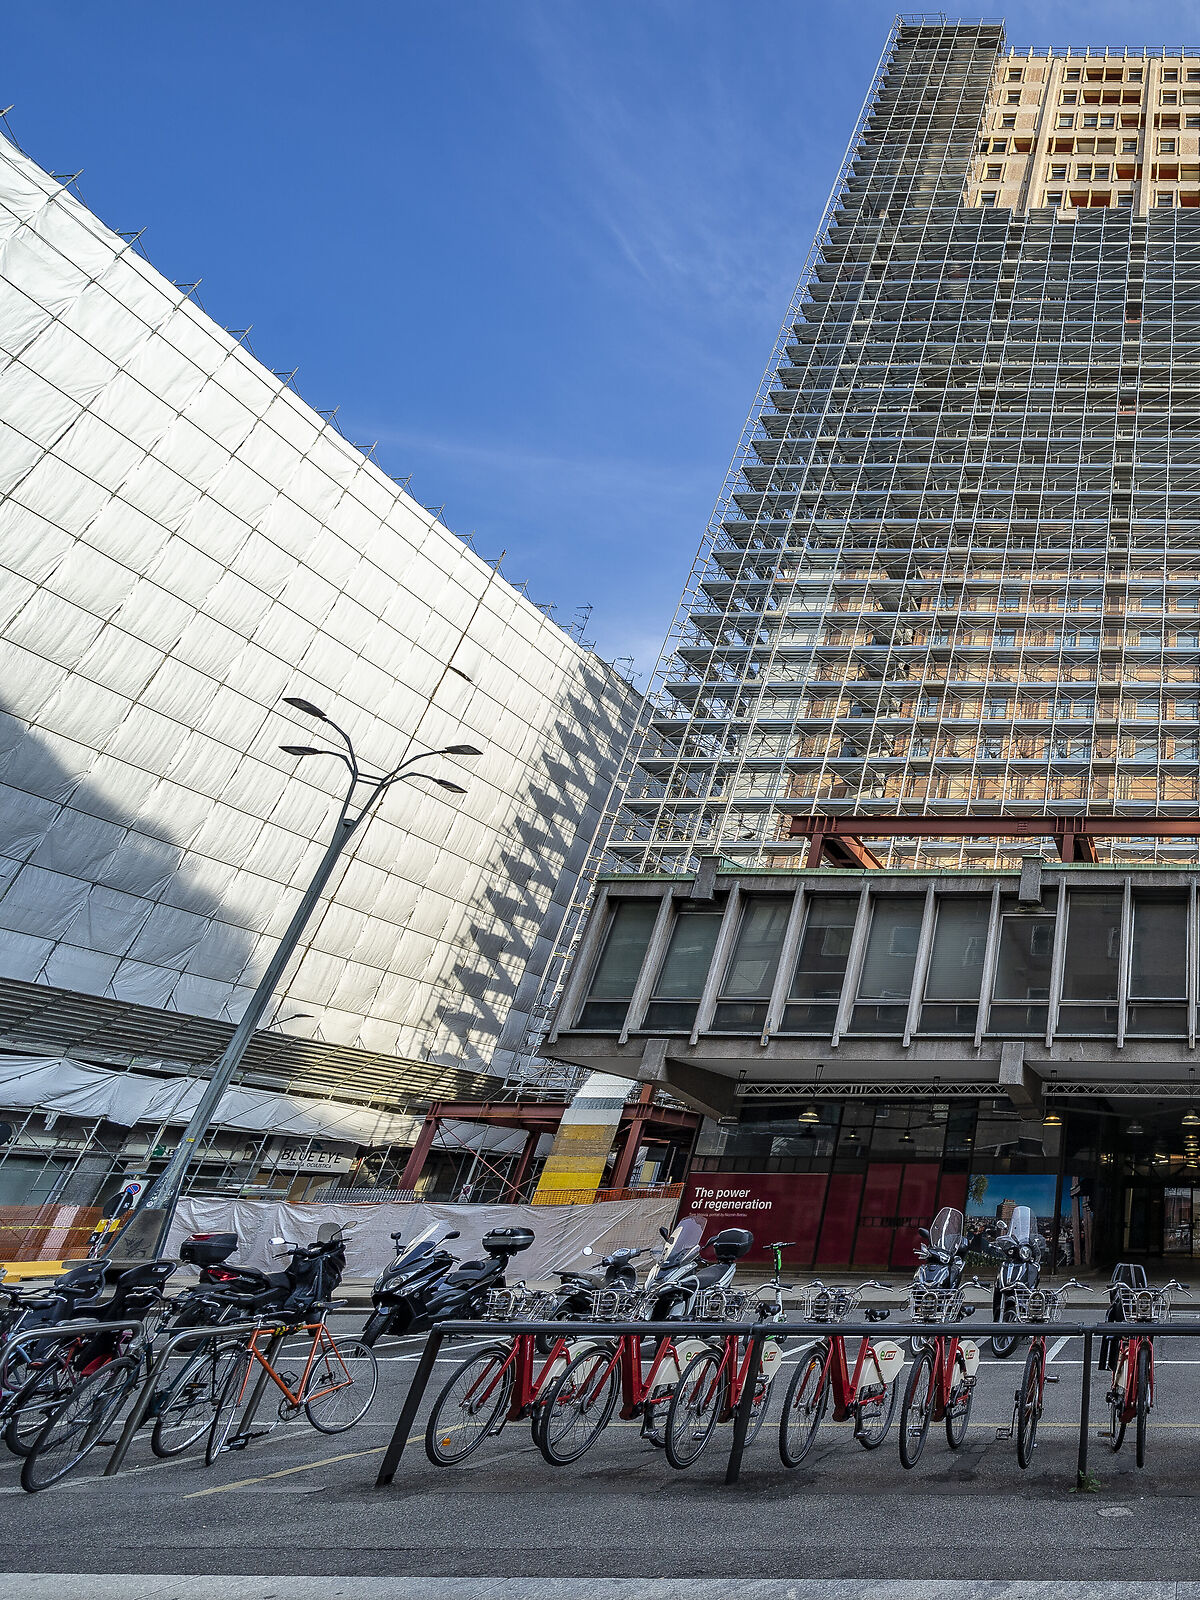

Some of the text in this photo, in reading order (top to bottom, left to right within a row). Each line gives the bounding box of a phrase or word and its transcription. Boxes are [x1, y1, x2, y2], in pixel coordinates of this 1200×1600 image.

[281, 1148, 344, 1164] BLUE EYE
[695, 1187, 751, 1200] The power
[691, 1199, 773, 1212] of regeneration
